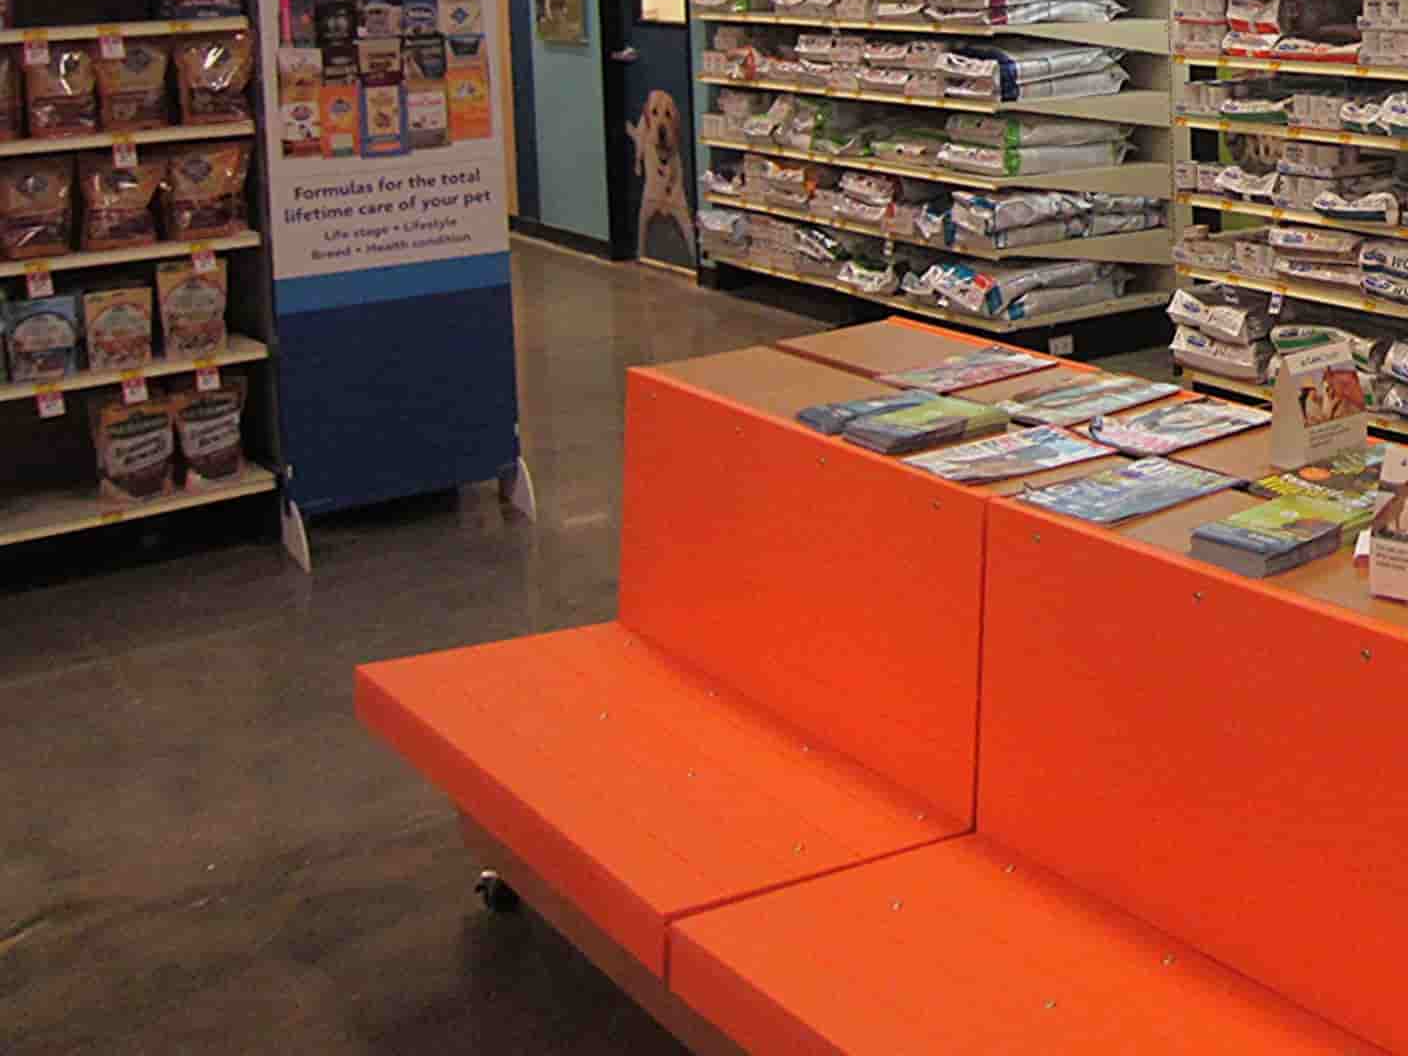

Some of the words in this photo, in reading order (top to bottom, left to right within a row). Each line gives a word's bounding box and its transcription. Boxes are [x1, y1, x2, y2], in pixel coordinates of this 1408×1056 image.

[294, 180, 374, 201] Formulas
[378, 176, 402, 193] for
[408, 172, 436, 188] the
[441, 168, 481, 185] total
[284, 205, 353, 225] lifetime
[359, 202, 393, 217] care
[398, 196, 416, 212] of
[421, 194, 458, 212] your
[463, 190, 492, 205] pet
[324, 229, 350, 242] Life
[353, 224, 388, 240] stage
[403, 216, 458, 233] Lifestyle
